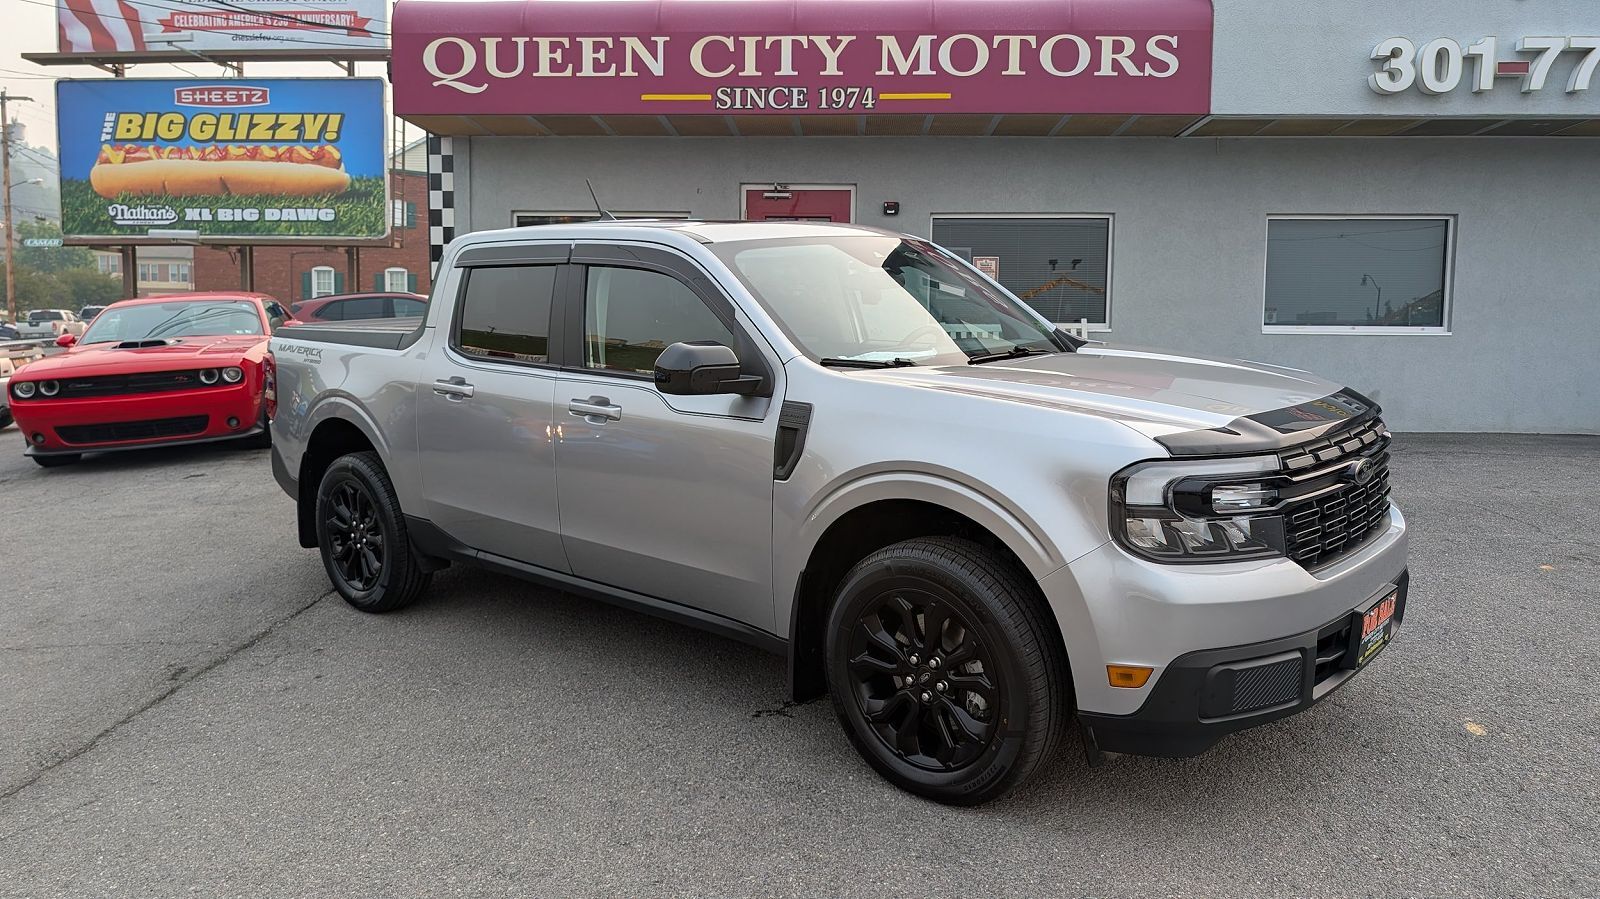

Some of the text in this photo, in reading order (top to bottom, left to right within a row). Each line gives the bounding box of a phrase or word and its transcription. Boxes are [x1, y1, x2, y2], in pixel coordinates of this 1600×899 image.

[173, 14, 227, 27] CELEBRATING
[295, 13, 355, 27] ANNIVERSARY!
[422, 34, 1179, 94] QUEEN CITY MOTORS
[181, 90, 264, 103] SHEETZ
[715, 87, 876, 109] SINCE 1974
[101, 112, 116, 141] THE
[114, 112, 344, 142] BIG GLIZZY!
[108, 204, 178, 221] Nathan's
[184, 208, 336, 221] XL BIG DAWG
[278, 343, 323, 359] MAVERICK
